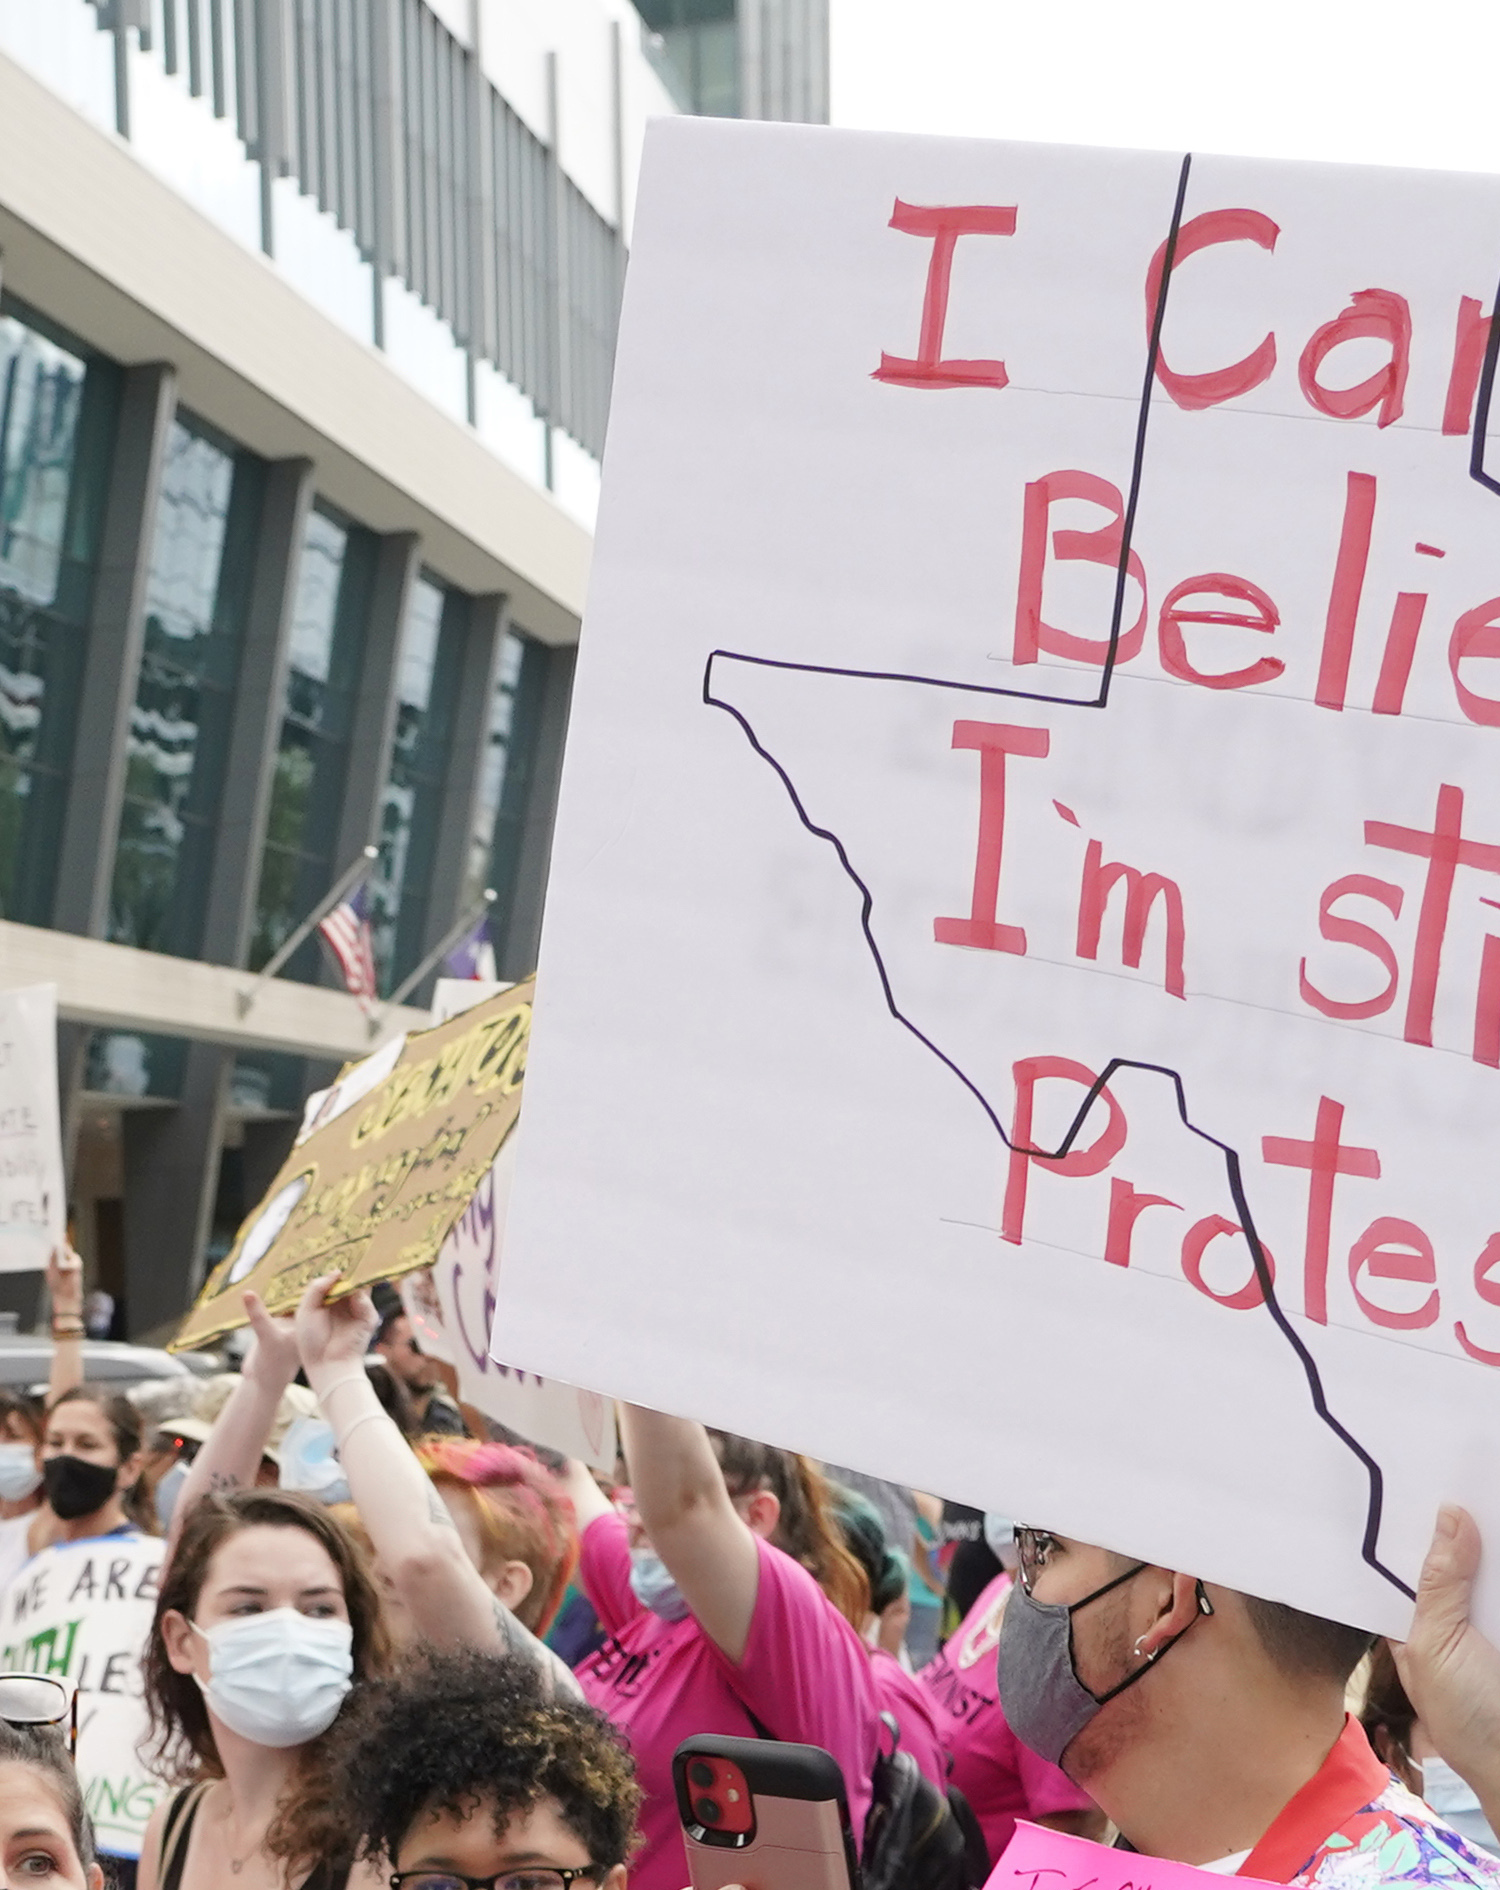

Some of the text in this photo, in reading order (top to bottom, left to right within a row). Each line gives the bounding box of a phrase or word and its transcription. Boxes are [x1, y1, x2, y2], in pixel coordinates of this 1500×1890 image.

[870, 196, 1017, 391] I
[933, 719, 1187, 999] I'm
[14, 1558, 160, 1624] WE ARE
